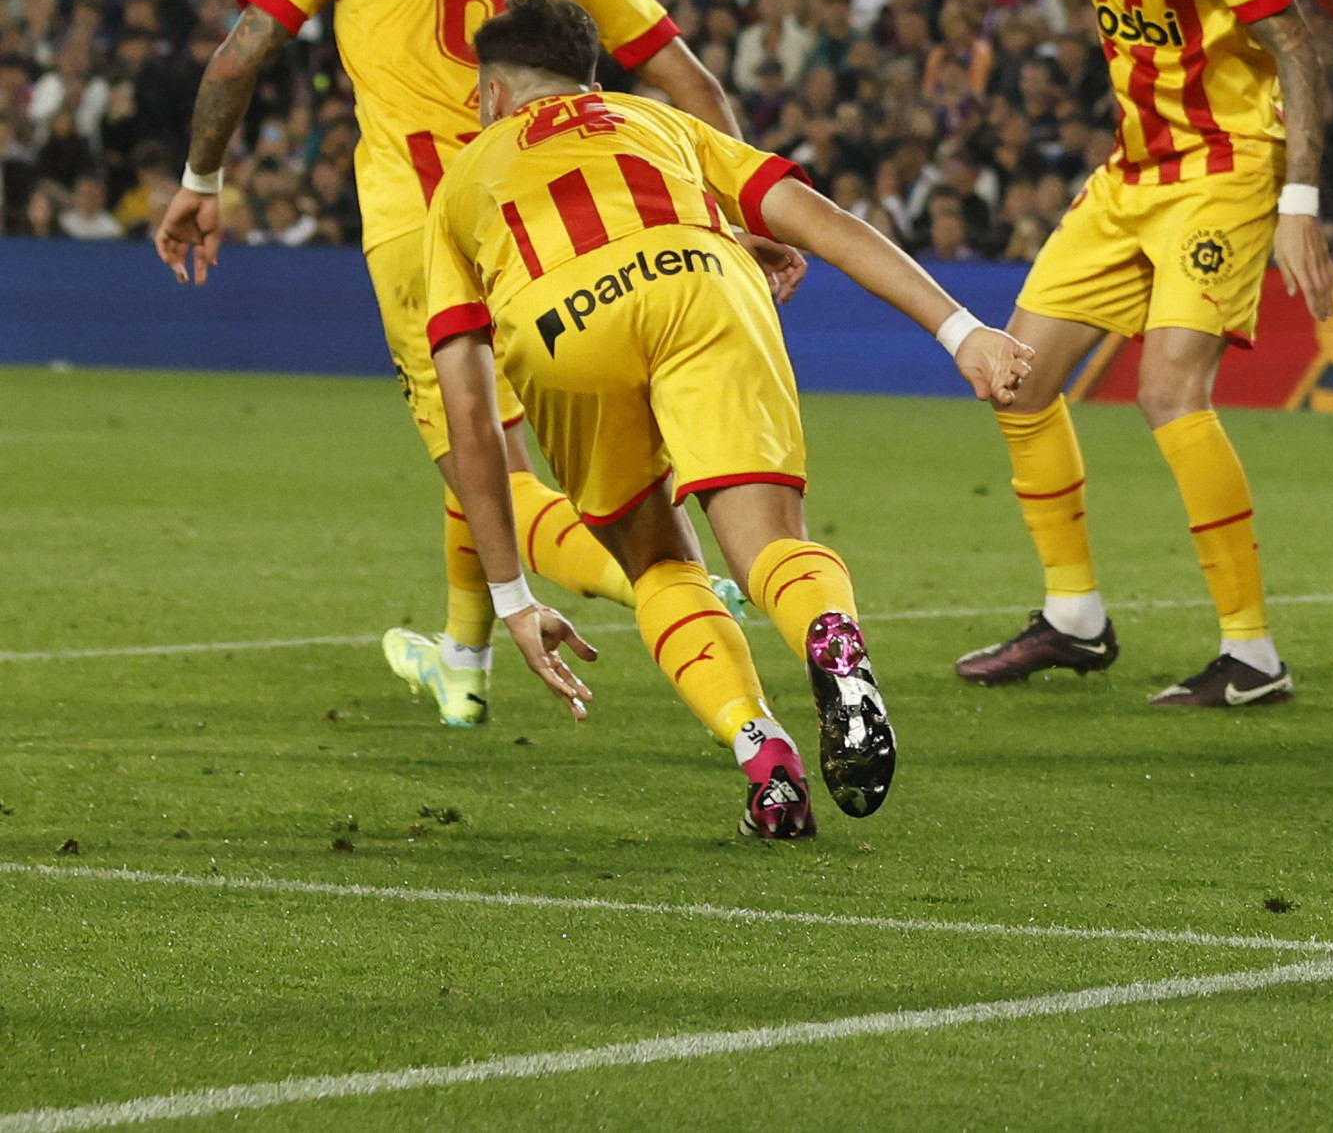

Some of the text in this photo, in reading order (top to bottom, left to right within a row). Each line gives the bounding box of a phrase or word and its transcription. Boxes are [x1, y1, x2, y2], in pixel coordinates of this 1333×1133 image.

[1096, 5, 1184, 48] osbi
[516, 93, 626, 152] 4
[564, 248, 724, 332] parlem
